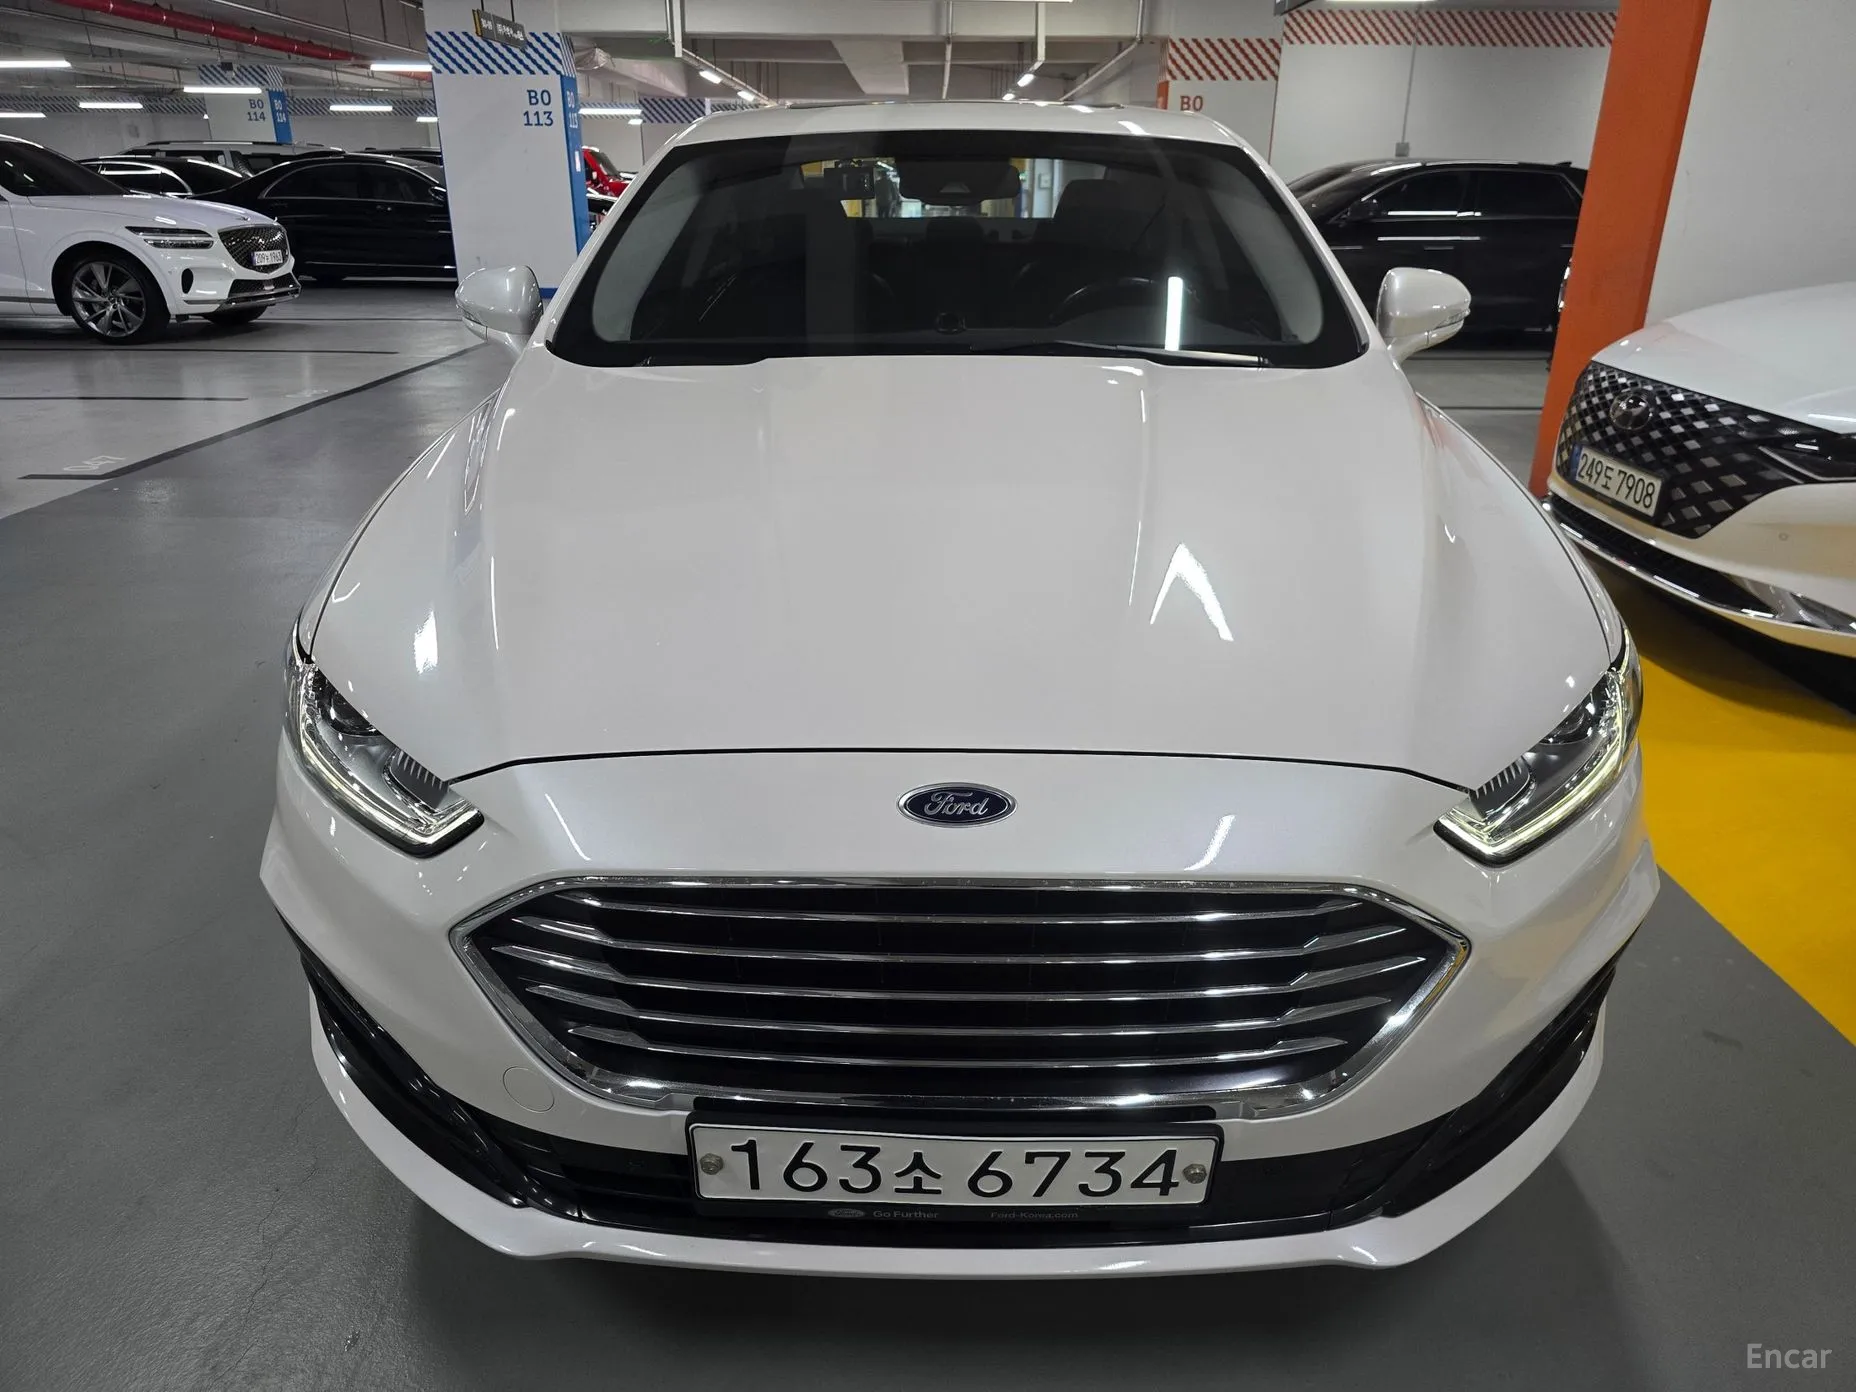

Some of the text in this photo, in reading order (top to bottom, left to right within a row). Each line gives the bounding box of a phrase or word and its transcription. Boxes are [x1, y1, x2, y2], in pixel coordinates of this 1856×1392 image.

[247, 111, 266, 121] 114
[523, 110, 554, 127] 113
[923, 791, 990, 816] Ford
[873, 1209, 892, 1219] Go
[893, 1210, 939, 1220] Further
